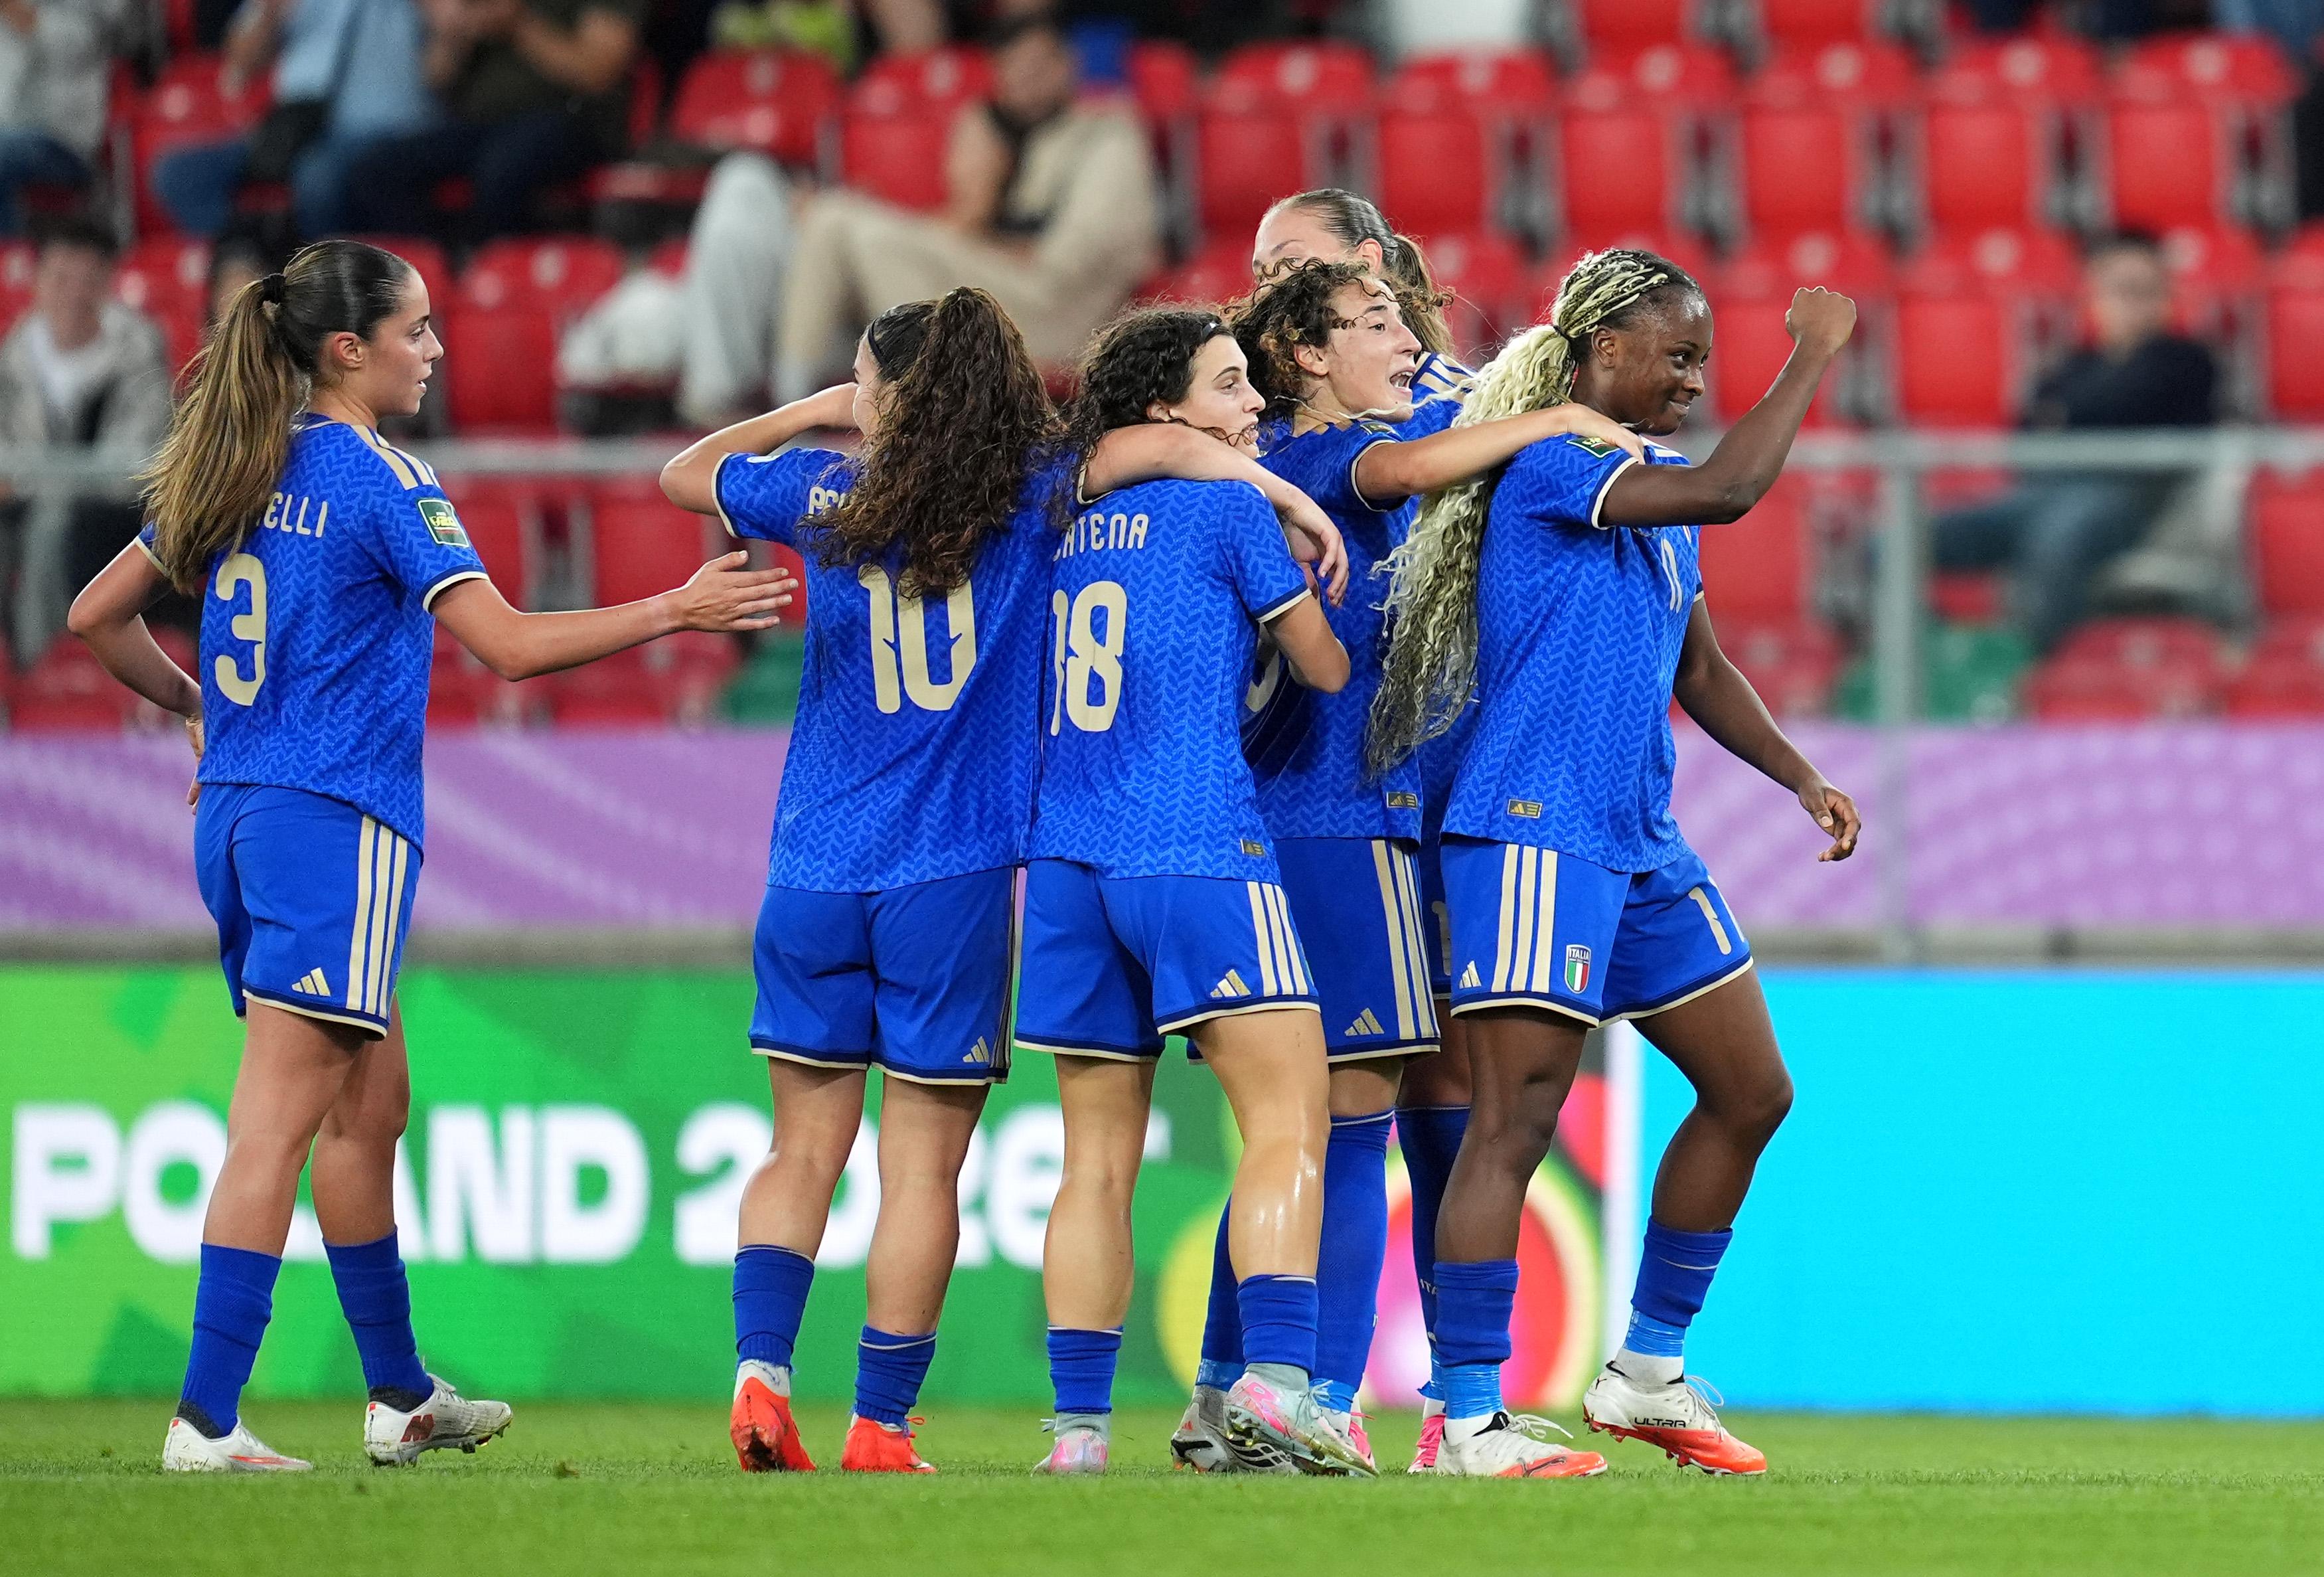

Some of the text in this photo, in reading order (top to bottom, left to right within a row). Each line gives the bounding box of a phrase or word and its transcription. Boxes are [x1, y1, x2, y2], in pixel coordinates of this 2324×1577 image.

[256, 492, 328, 539] ELLI
[215, 553, 267, 706] 3
[858, 564, 977, 714] 10
[1050, 580, 1128, 736] 18
[1569, 948, 1590, 961] ITALIA
[1634, 1416, 1687, 1428] ULTRA
